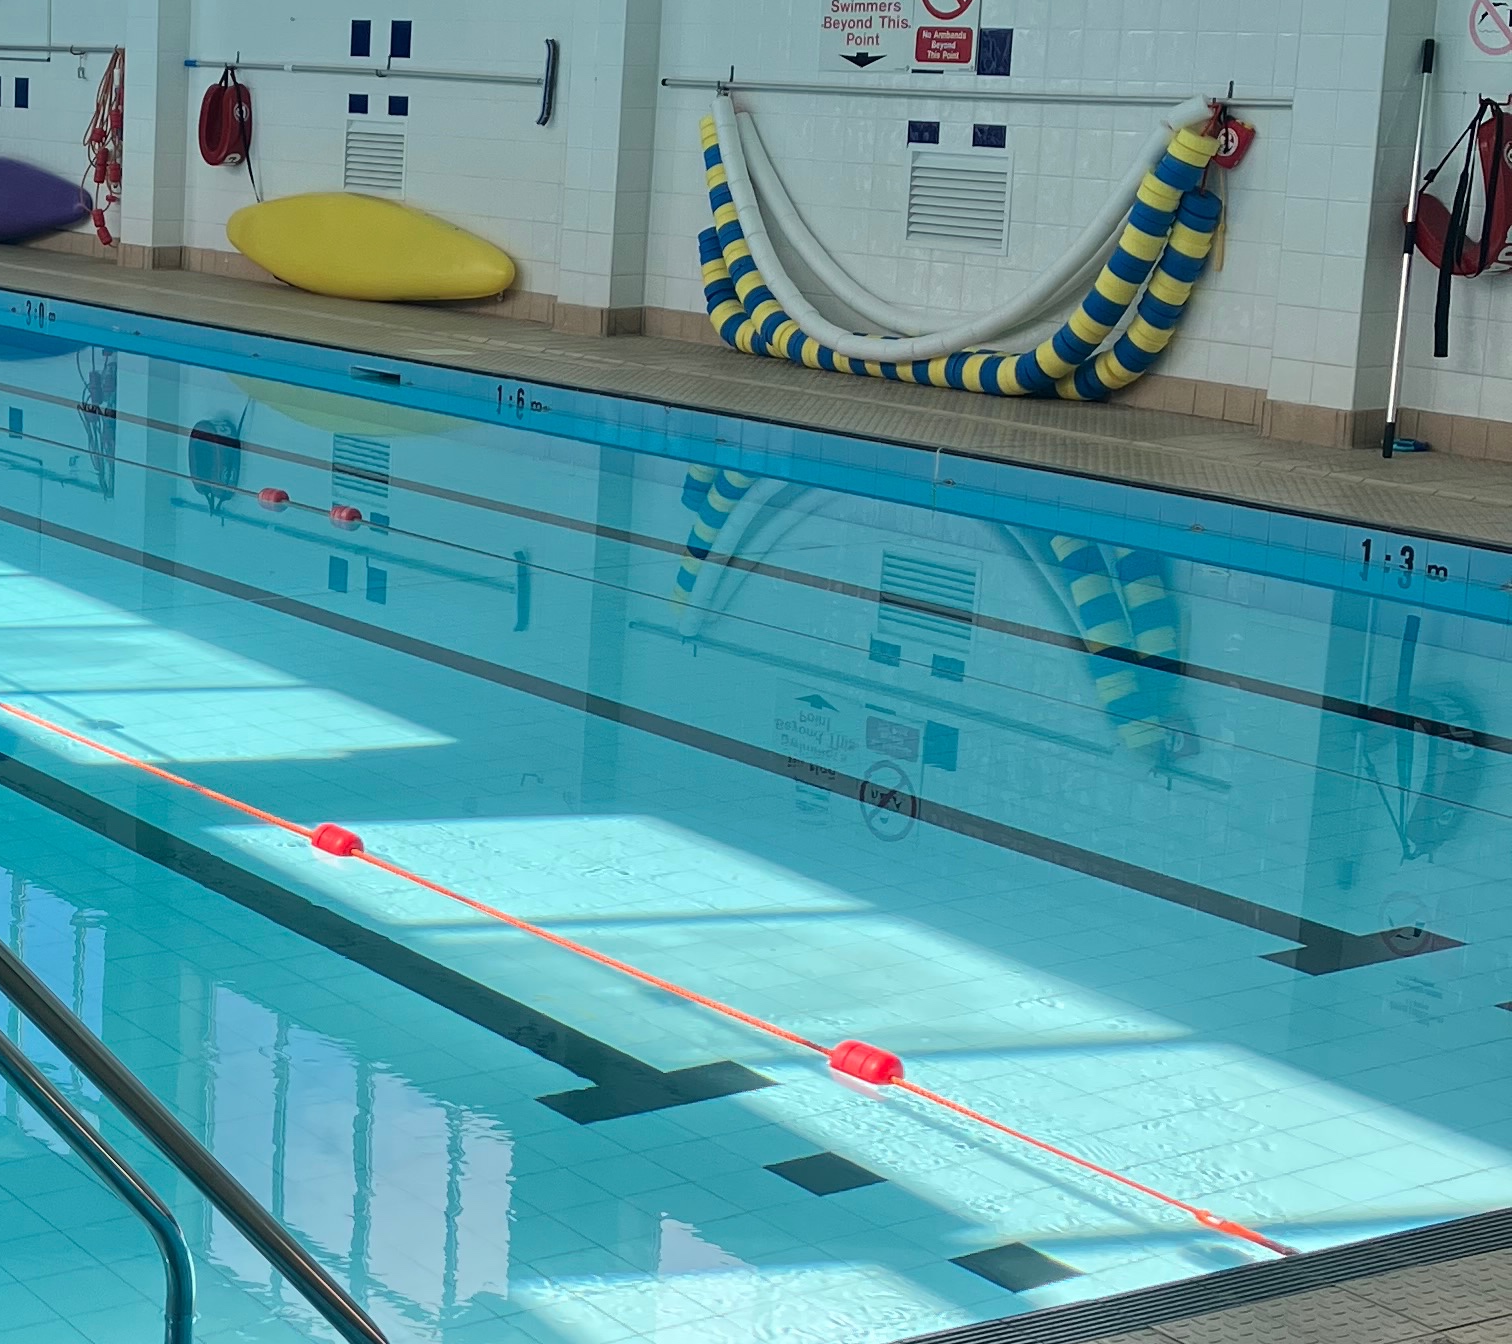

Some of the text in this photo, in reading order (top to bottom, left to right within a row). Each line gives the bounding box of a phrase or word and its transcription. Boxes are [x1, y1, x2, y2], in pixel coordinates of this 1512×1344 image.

[831, 0, 901, 13] Swimmers
[824, 16, 908, 31] Beyond This
[846, 32, 880, 46] Point
